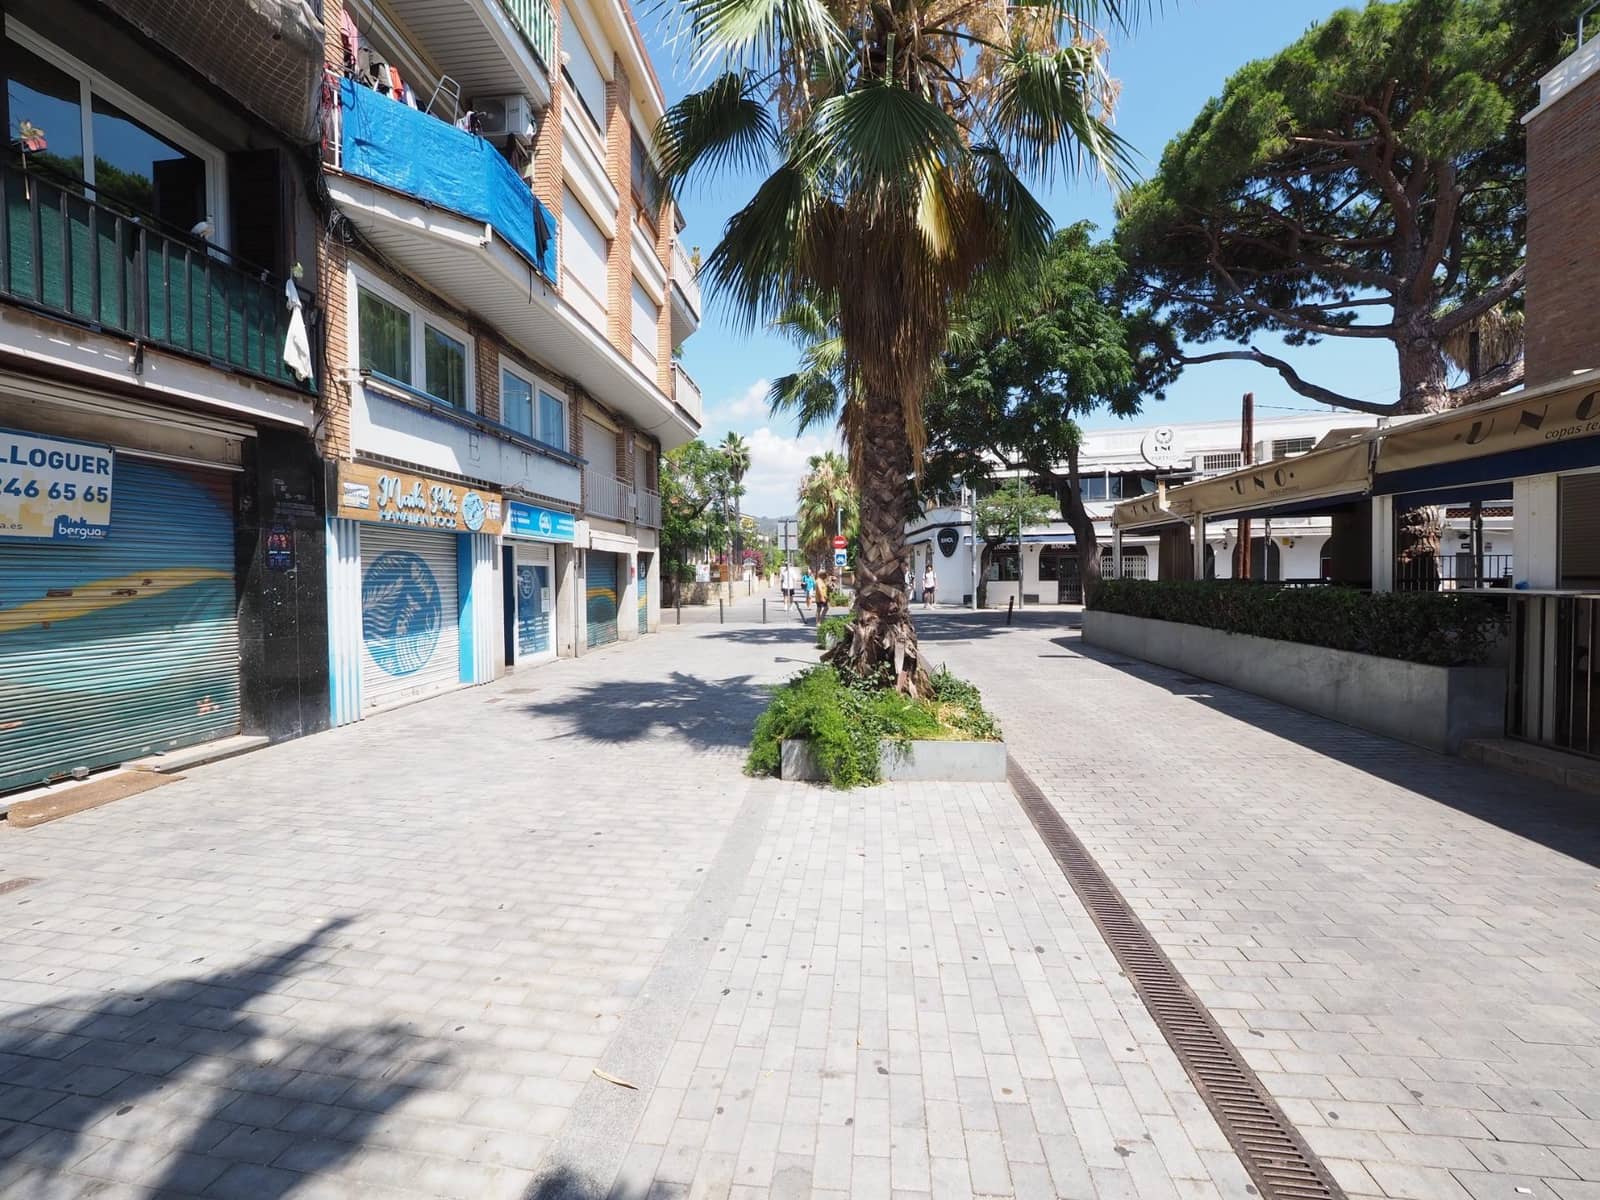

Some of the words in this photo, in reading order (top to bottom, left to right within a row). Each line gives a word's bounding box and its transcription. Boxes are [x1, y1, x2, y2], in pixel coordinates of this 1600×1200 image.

[1545, 424, 1581, 440] copas
[1584, 419, 1600, 433] te
[0, 477, 40, 498] 46
[48, 481, 77, 501] 65
[83, 485, 109, 503] 65
[58, 522, 102, 540] bergua
[430, 515, 458, 529] FOOD
